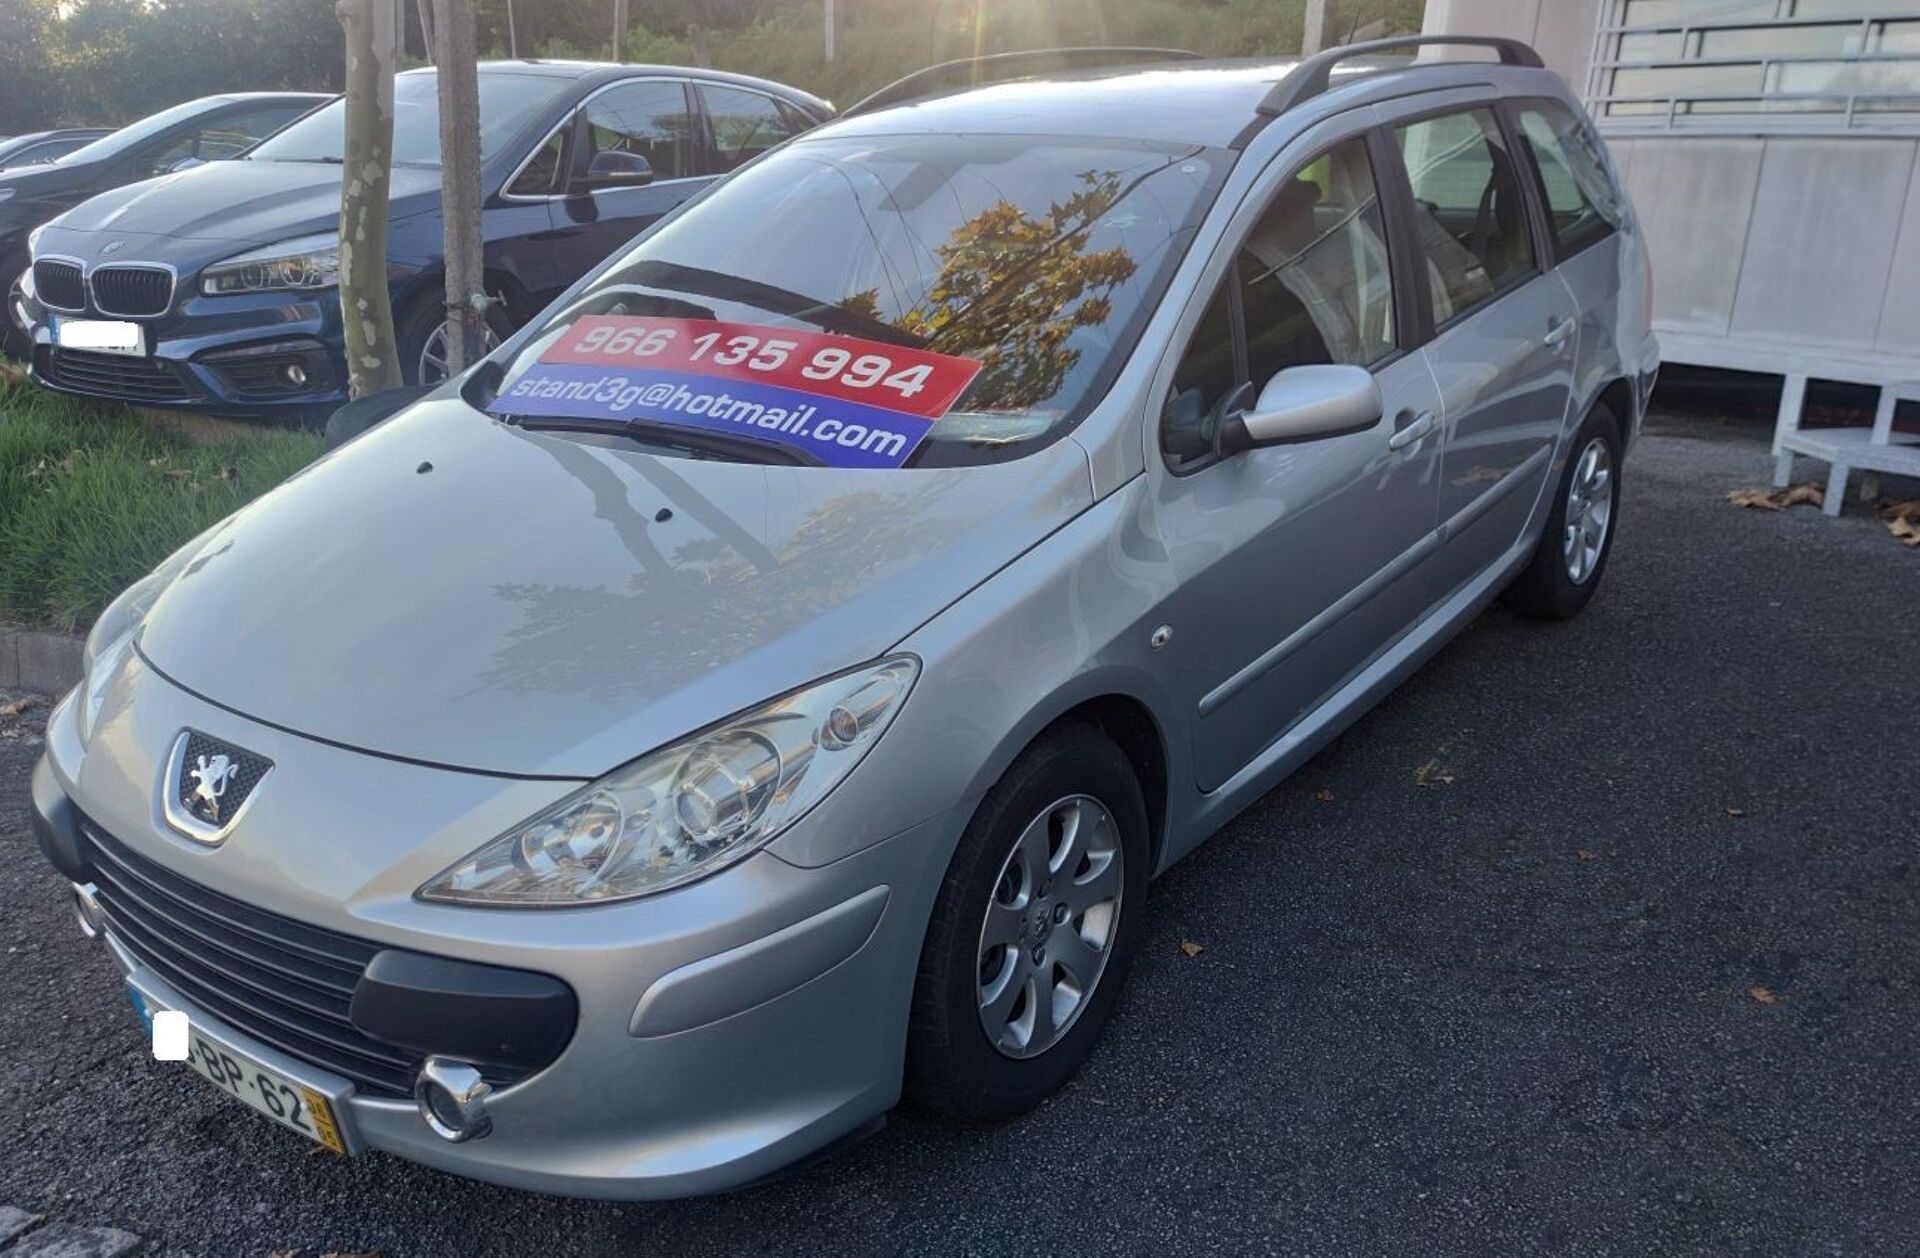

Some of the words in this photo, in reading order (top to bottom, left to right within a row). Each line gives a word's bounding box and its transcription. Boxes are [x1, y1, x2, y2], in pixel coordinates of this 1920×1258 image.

[575, 326, 677, 357] 966
[689, 333, 798, 371] 135
[802, 348, 934, 398] 994
[512, 376, 908, 456] stand3g@hotmail.com
[187, 1039, 310, 1131] -BP-62
